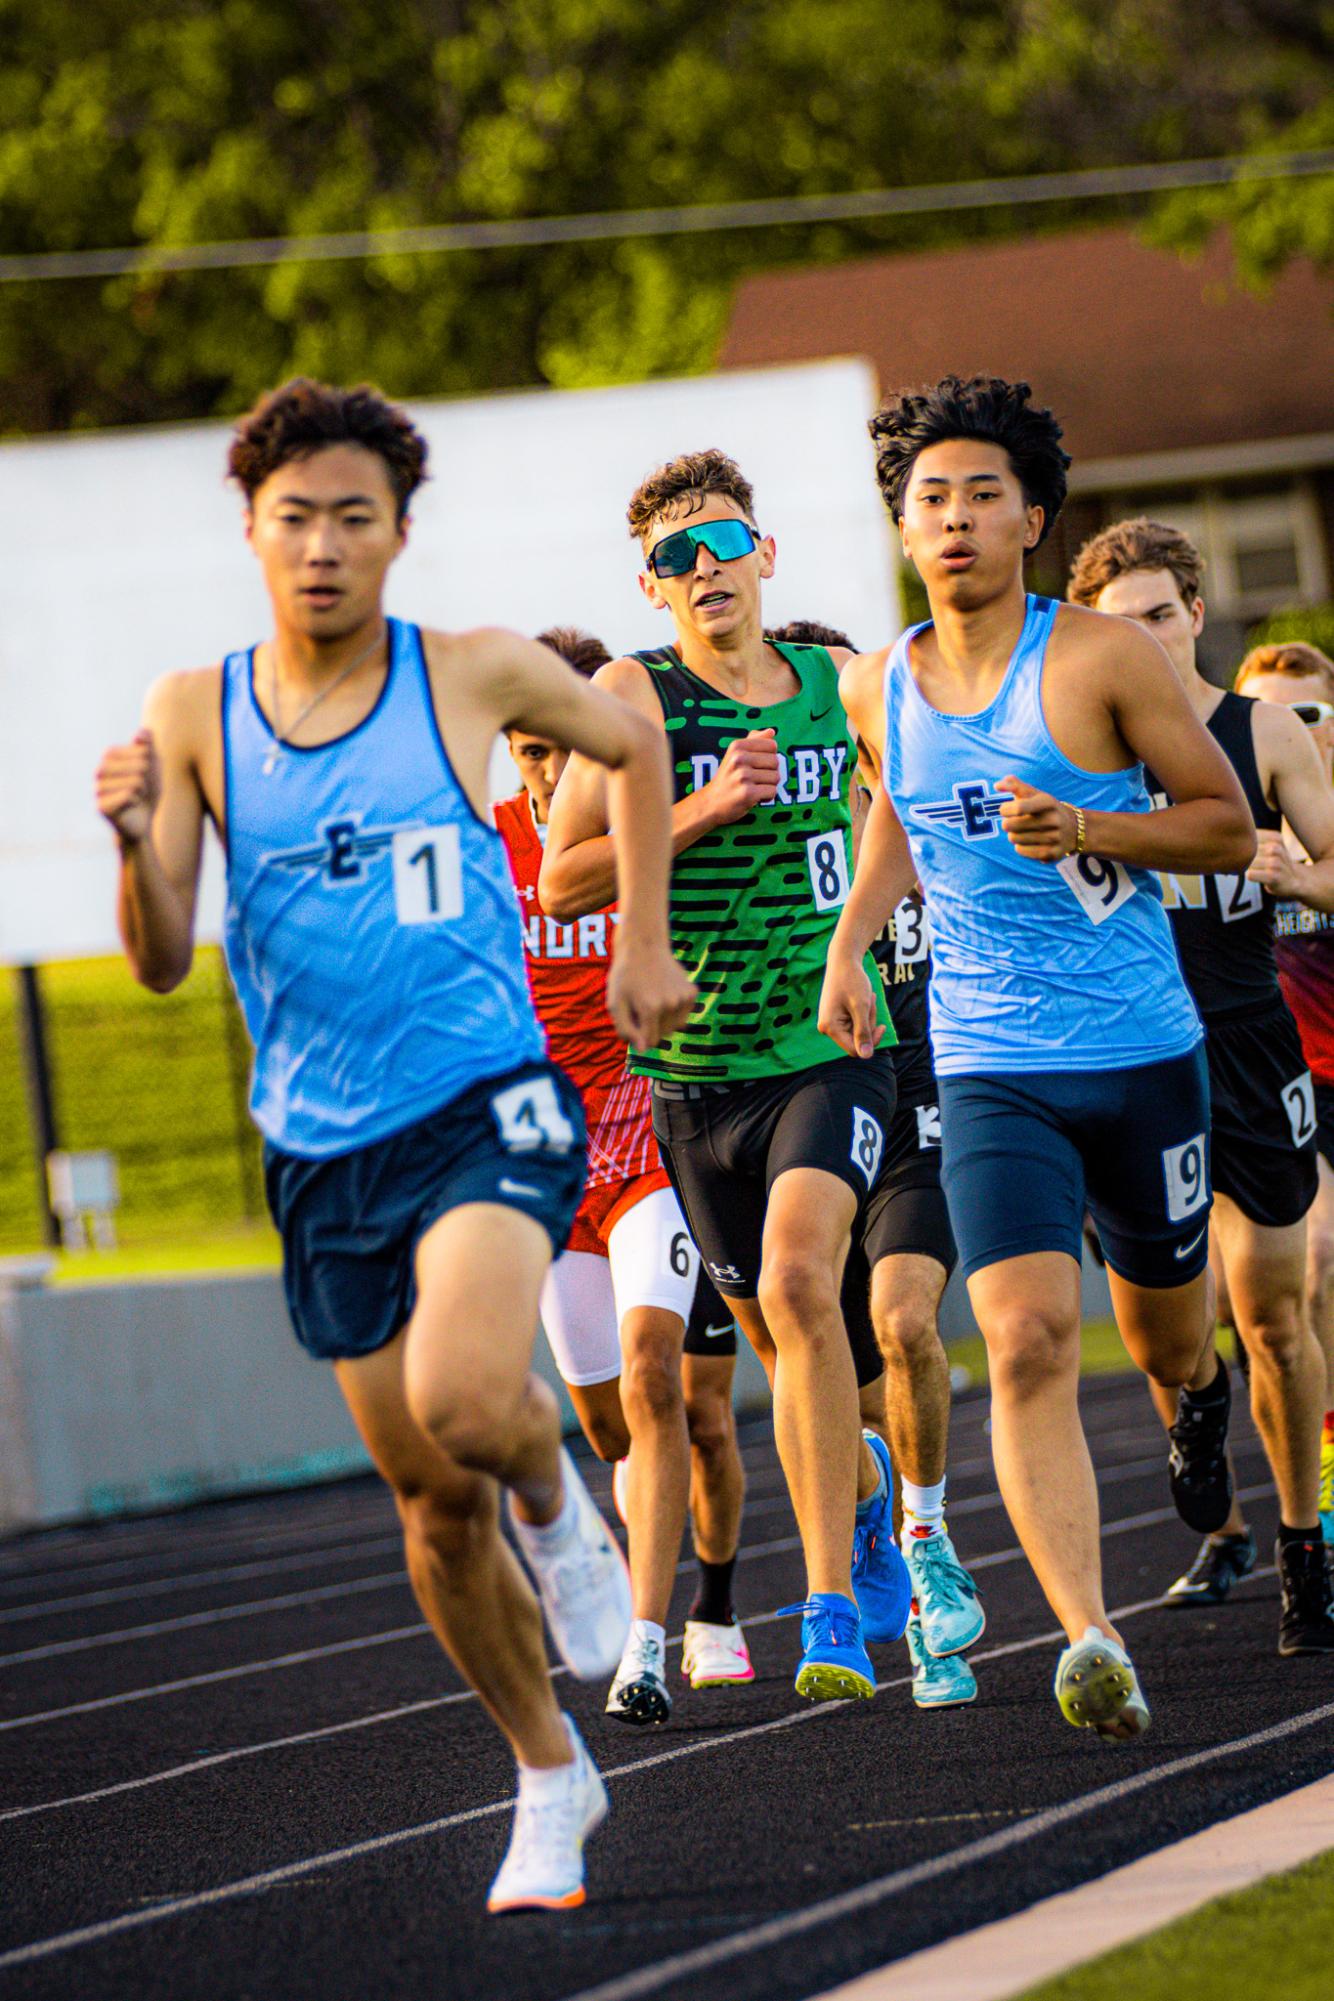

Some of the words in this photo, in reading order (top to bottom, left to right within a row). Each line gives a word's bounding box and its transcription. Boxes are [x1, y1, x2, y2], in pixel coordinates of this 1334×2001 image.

[690, 747, 847, 807] DRBY
[409, 841, 440, 915] 1
[814, 840, 841, 901] 8
[1077, 853, 1119, 907] 9
[521, 913, 624, 959] NOR
[901, 902, 923, 957] 3
[1288, 1086, 1312, 1139] 2
[858, 1118, 878, 1173] 8
[1179, 1142, 1201, 1208] 9
[669, 1231, 691, 1278] 6
